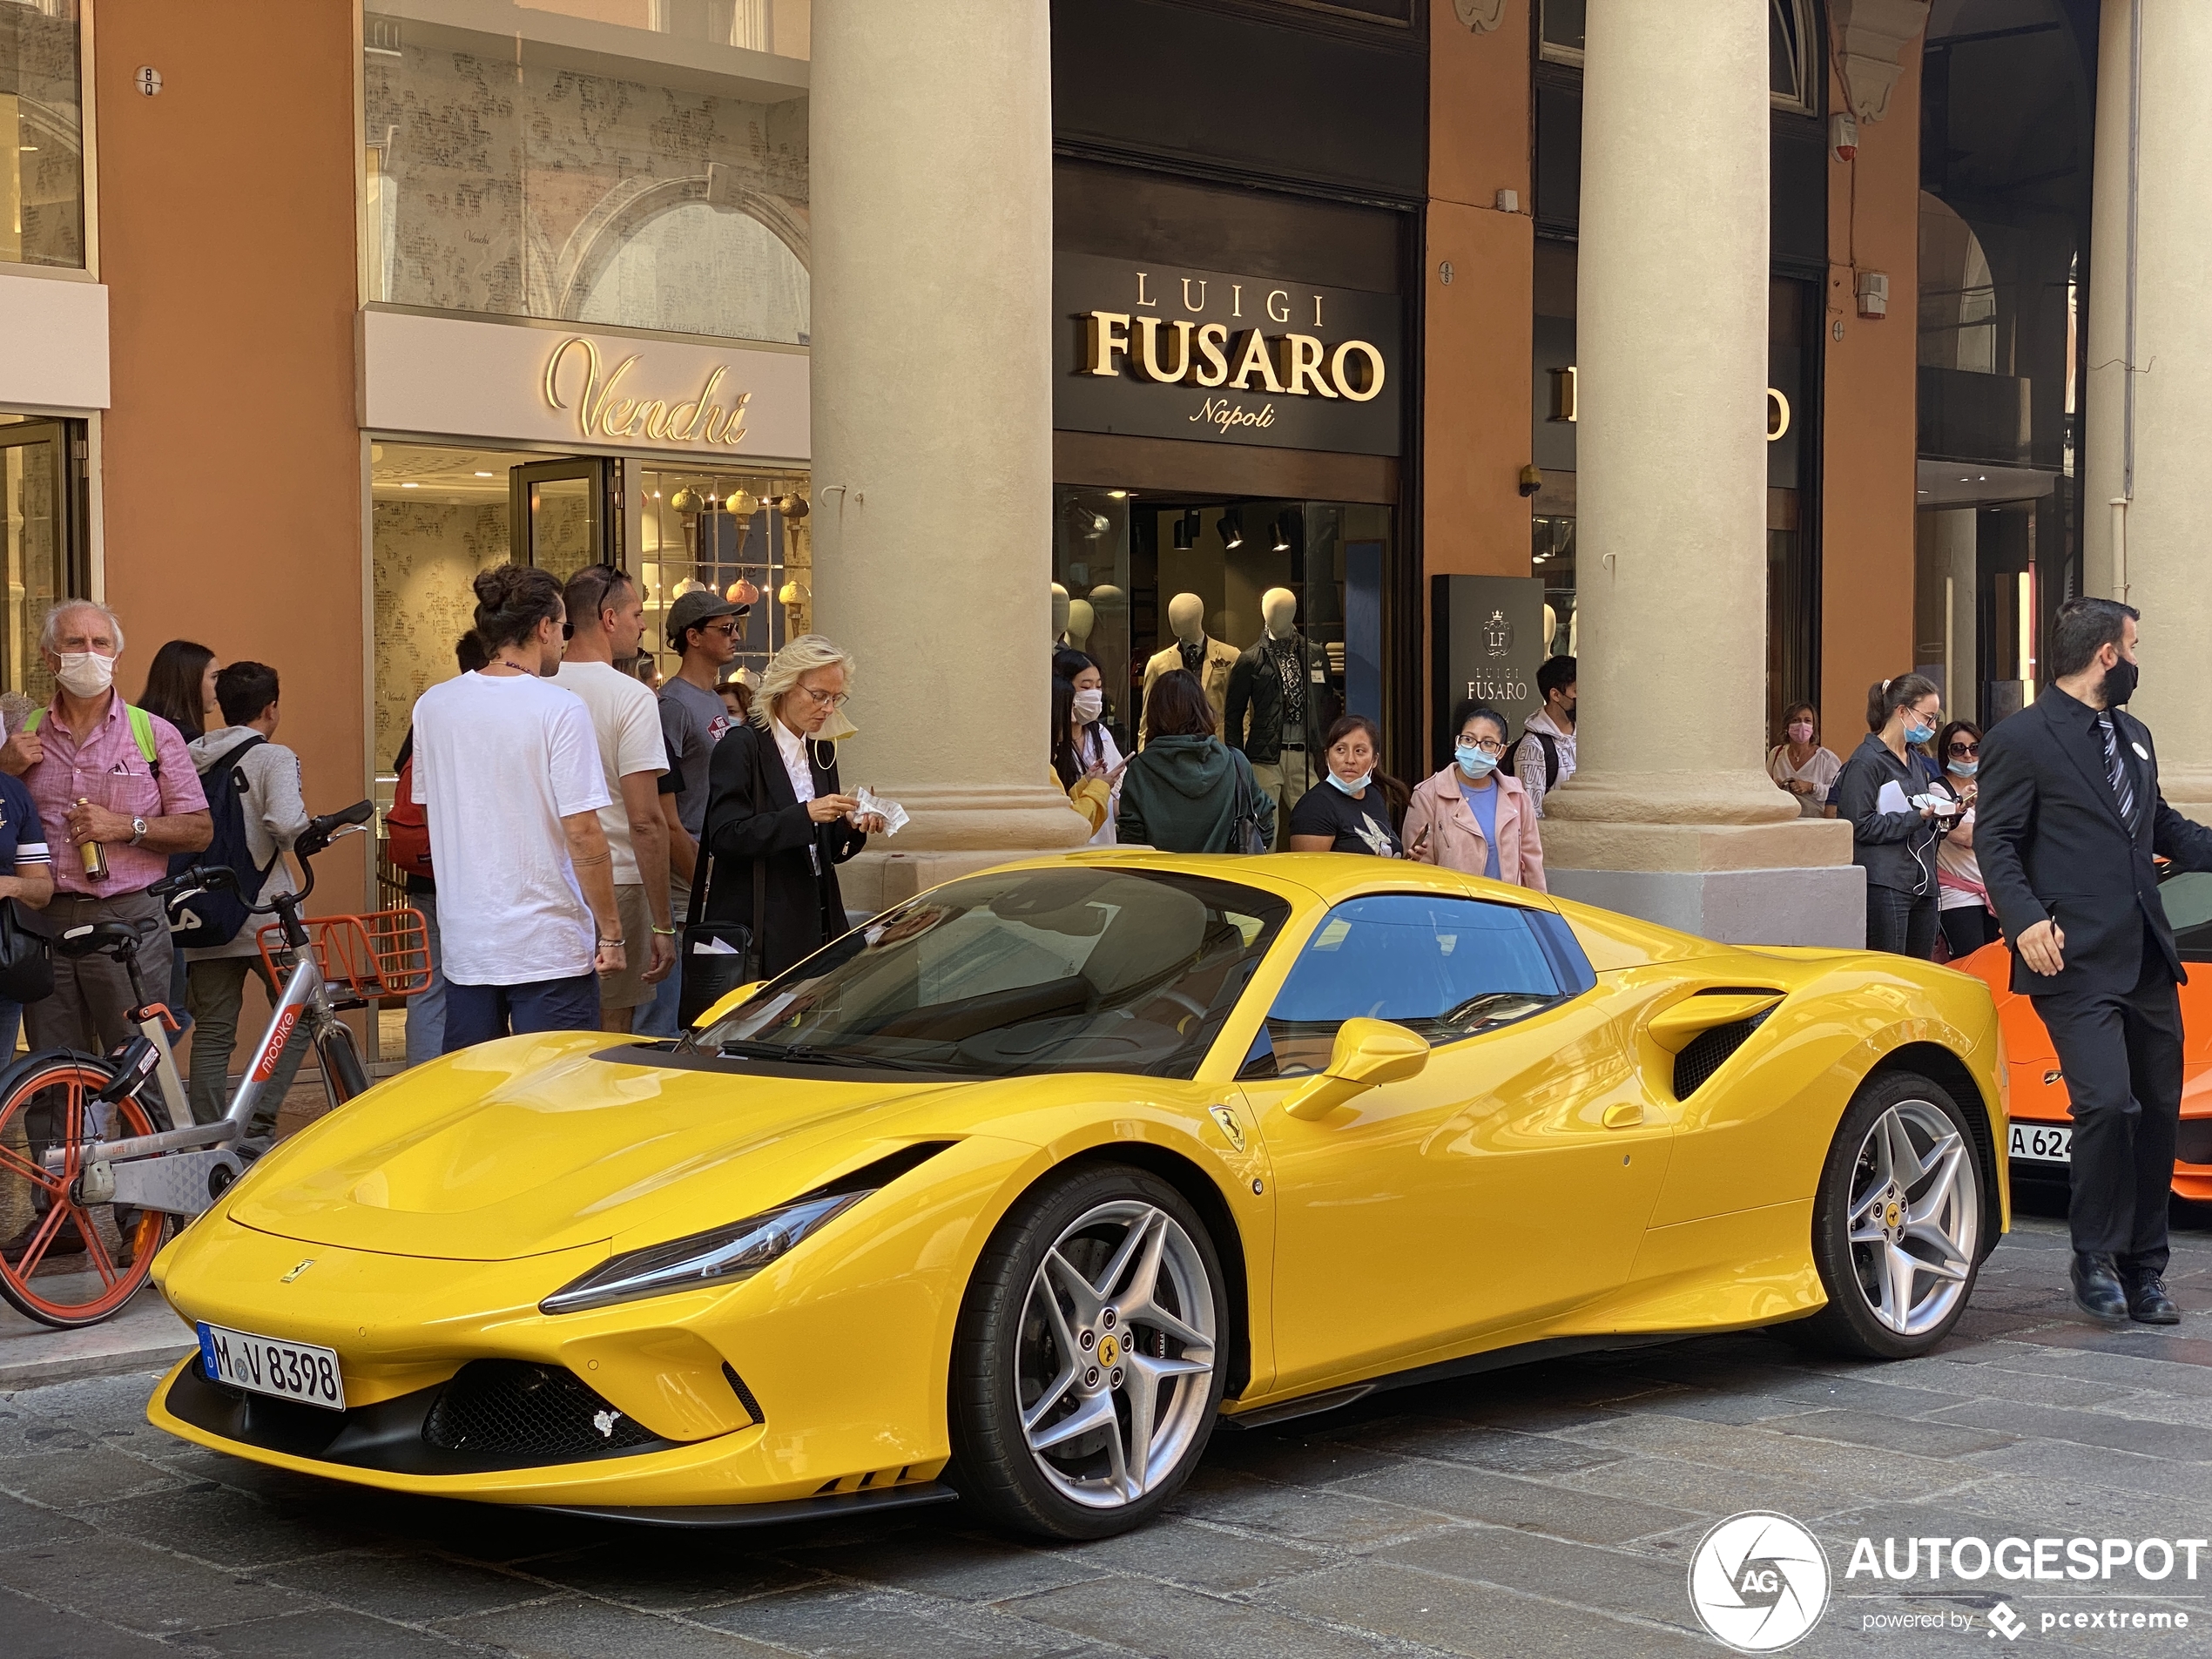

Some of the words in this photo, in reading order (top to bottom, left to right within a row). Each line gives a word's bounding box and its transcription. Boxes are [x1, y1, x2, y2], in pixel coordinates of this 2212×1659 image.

[463, 228, 491, 246] Venchi
[1136, 271, 1324, 327] LUIGI
[1089, 309, 1386, 403] FUSARO
[544, 336, 753, 445] Venchi
[1188, 396, 1276, 434] Napoli
[1488, 631, 1506, 647] LF
[1475, 667, 1520, 678] LUIGI
[384, 691, 407, 702] Venchi
[1467, 681, 1527, 701] FUSARO
[261, 1012, 294, 1075] mobike
[2011, 1128, 2026, 1154] A
[212, 1333, 233, 1378] M
[243, 1341, 261, 1386] V
[266, 1345, 338, 1401] 8398
